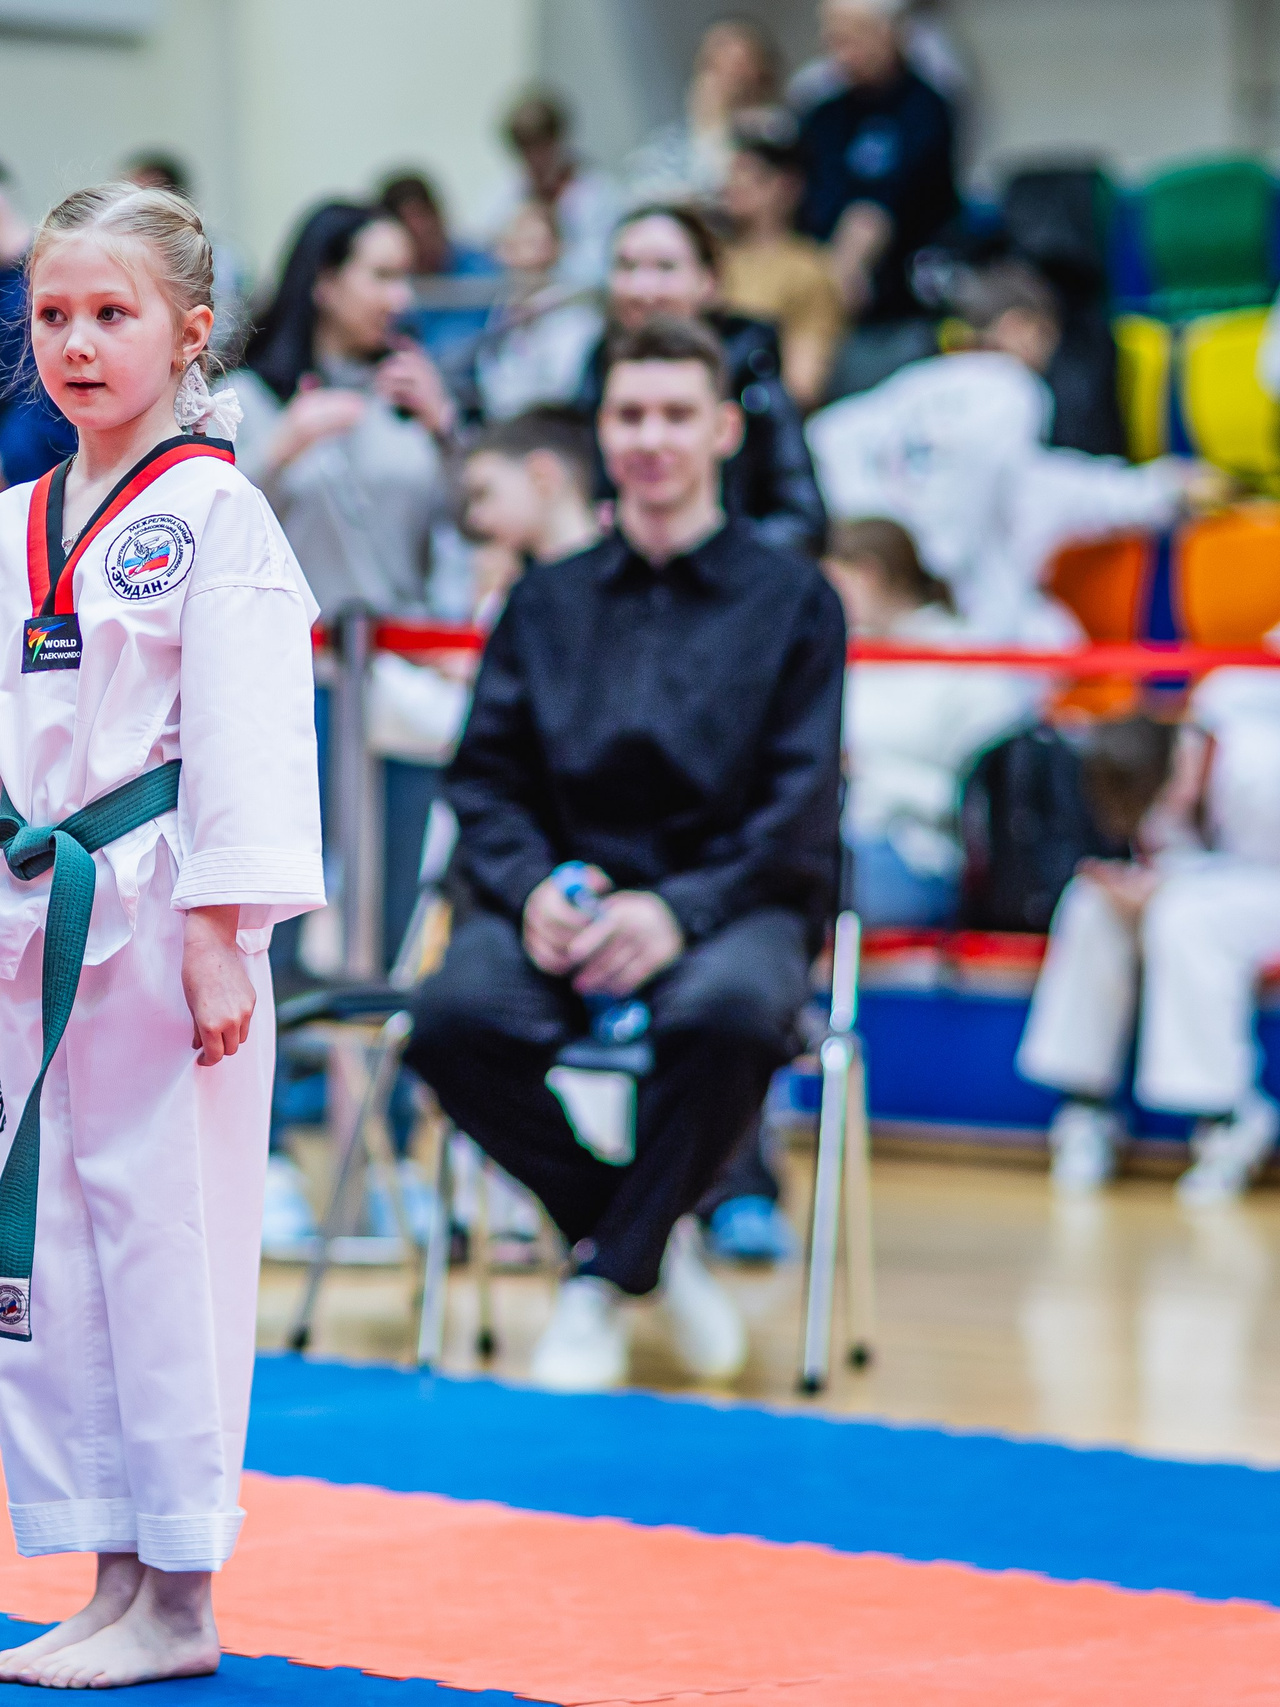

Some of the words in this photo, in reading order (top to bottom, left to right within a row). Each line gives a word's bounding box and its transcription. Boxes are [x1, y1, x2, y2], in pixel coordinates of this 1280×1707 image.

[129, 517, 193, 545] МЕЖРЕГИОНАЛЬНЫЙ
[44, 638, 77, 649] WORLD
[39, 650, 81, 661] TAEKWONDO
